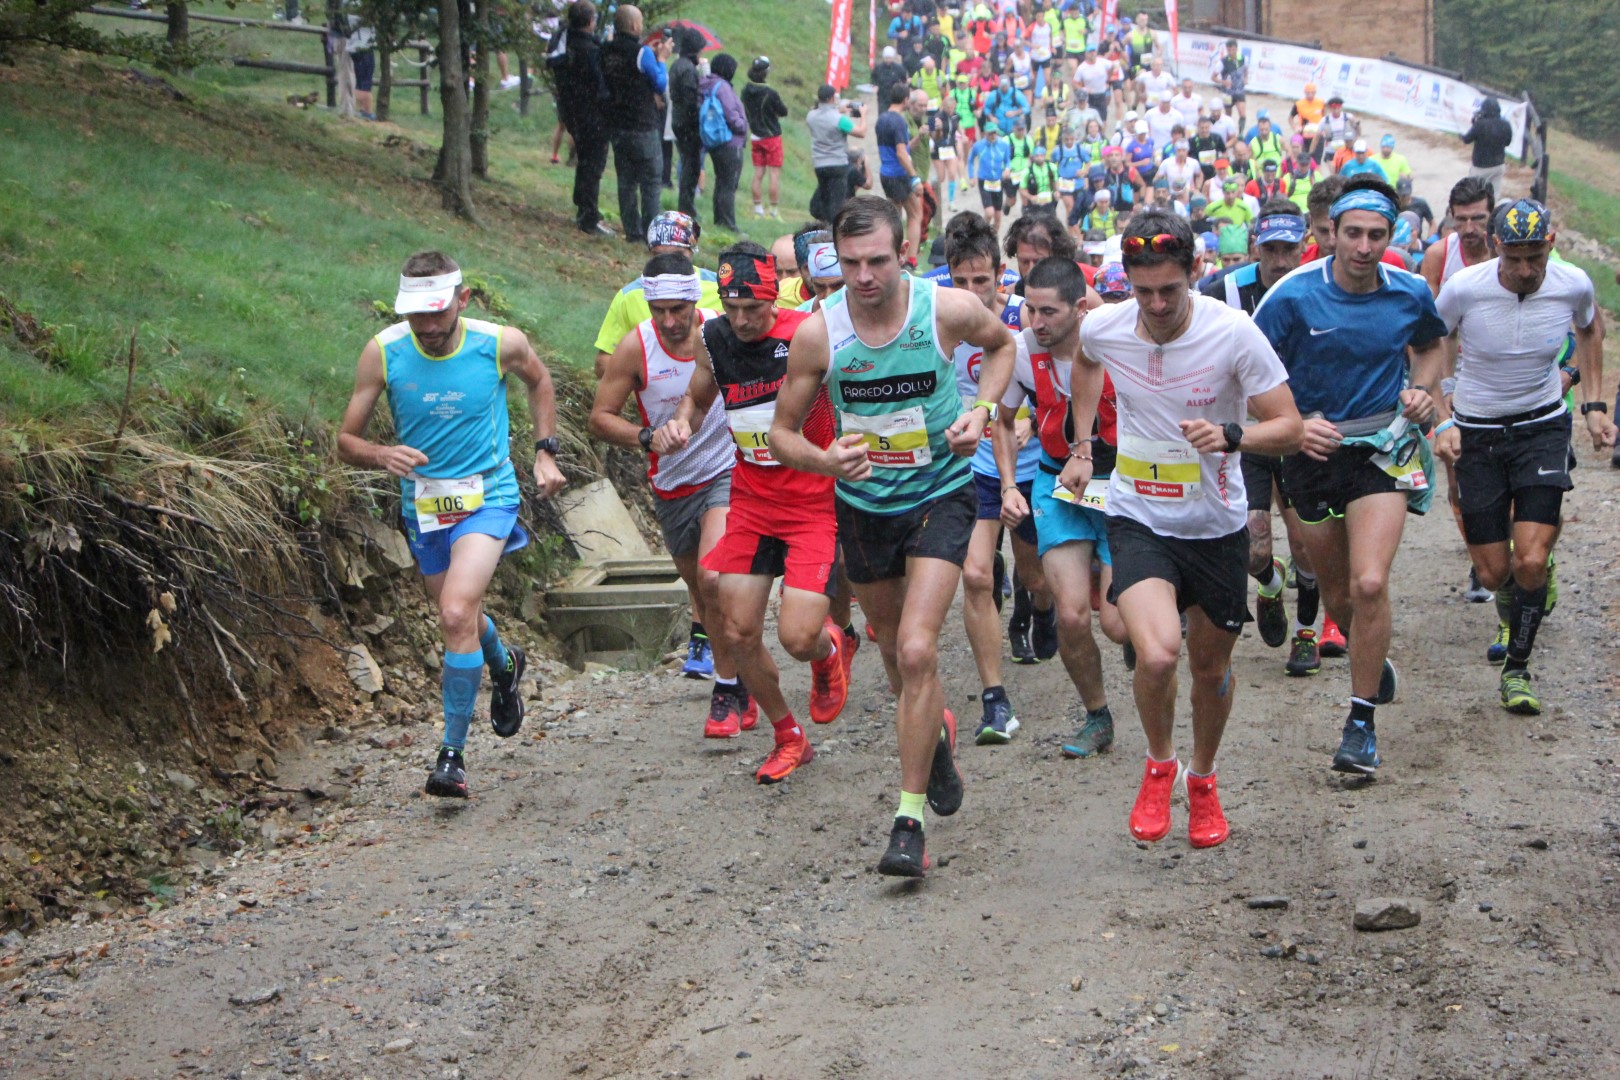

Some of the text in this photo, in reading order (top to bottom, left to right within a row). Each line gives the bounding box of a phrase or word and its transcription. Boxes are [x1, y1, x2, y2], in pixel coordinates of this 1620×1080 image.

[844, 380, 931, 397] ARREDO JOLLY
[879, 436, 890, 450] 5
[871, 454, 910, 462] VIESSMANN
[1149, 464, 1157, 479] 1
[1138, 485, 1179, 494] VIESSMANN
[435, 496, 464, 512] 106
